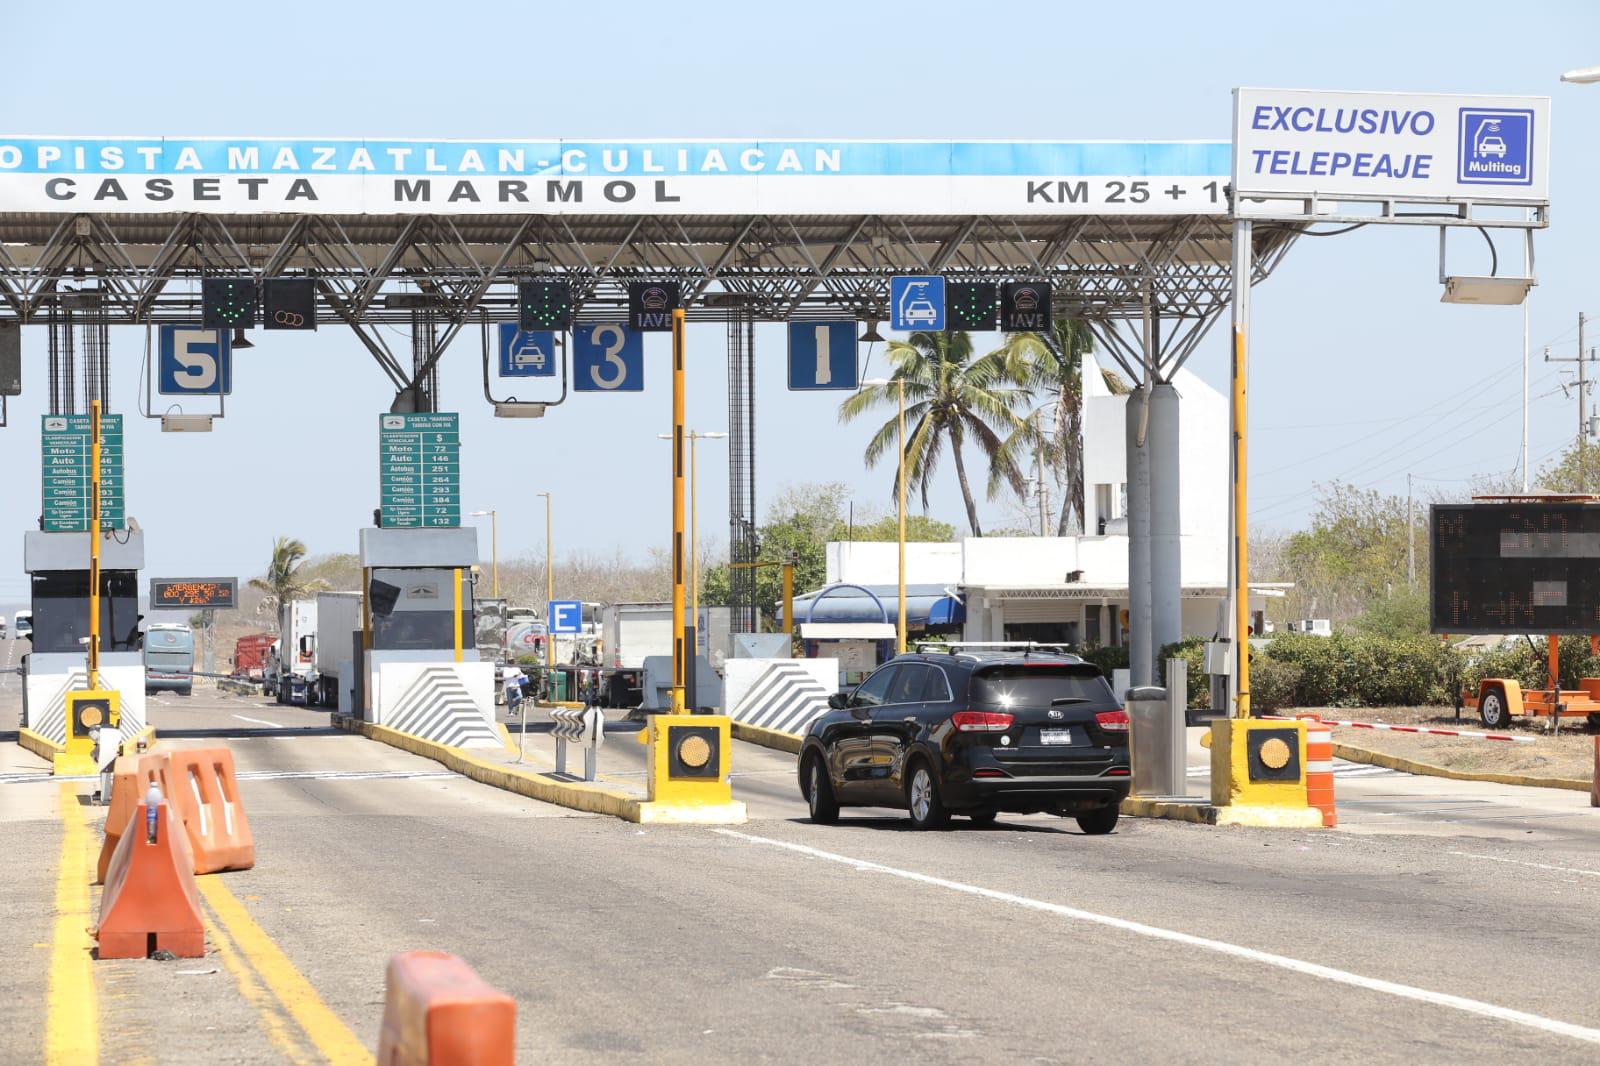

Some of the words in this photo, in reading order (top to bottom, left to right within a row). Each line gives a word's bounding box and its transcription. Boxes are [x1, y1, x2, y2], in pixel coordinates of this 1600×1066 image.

[1251, 106, 1435, 136] EXCLUSIVO
[1251, 150, 1433, 179] TELEPEAJE
[1468, 160, 1522, 176] Multitag
[45, 178, 319, 202] CASETA
[394, 179, 681, 203] MARMOL
[1027, 181, 1089, 203] KM
[1104, 181, 1151, 204] 25
[1010, 313, 1044, 328] IAVE
[172, 329, 217, 389] 5
[590, 323, 628, 390] 3
[814, 325, 832, 385] 1
[436, 434, 443, 442] $
[51, 457, 75, 465] Auto
[390, 454, 413, 462] Auto
[431, 465, 449, 473] 251
[435, 506, 447, 514] 72
[101, 520, 113, 528] 32
[554, 604, 577, 631] E
